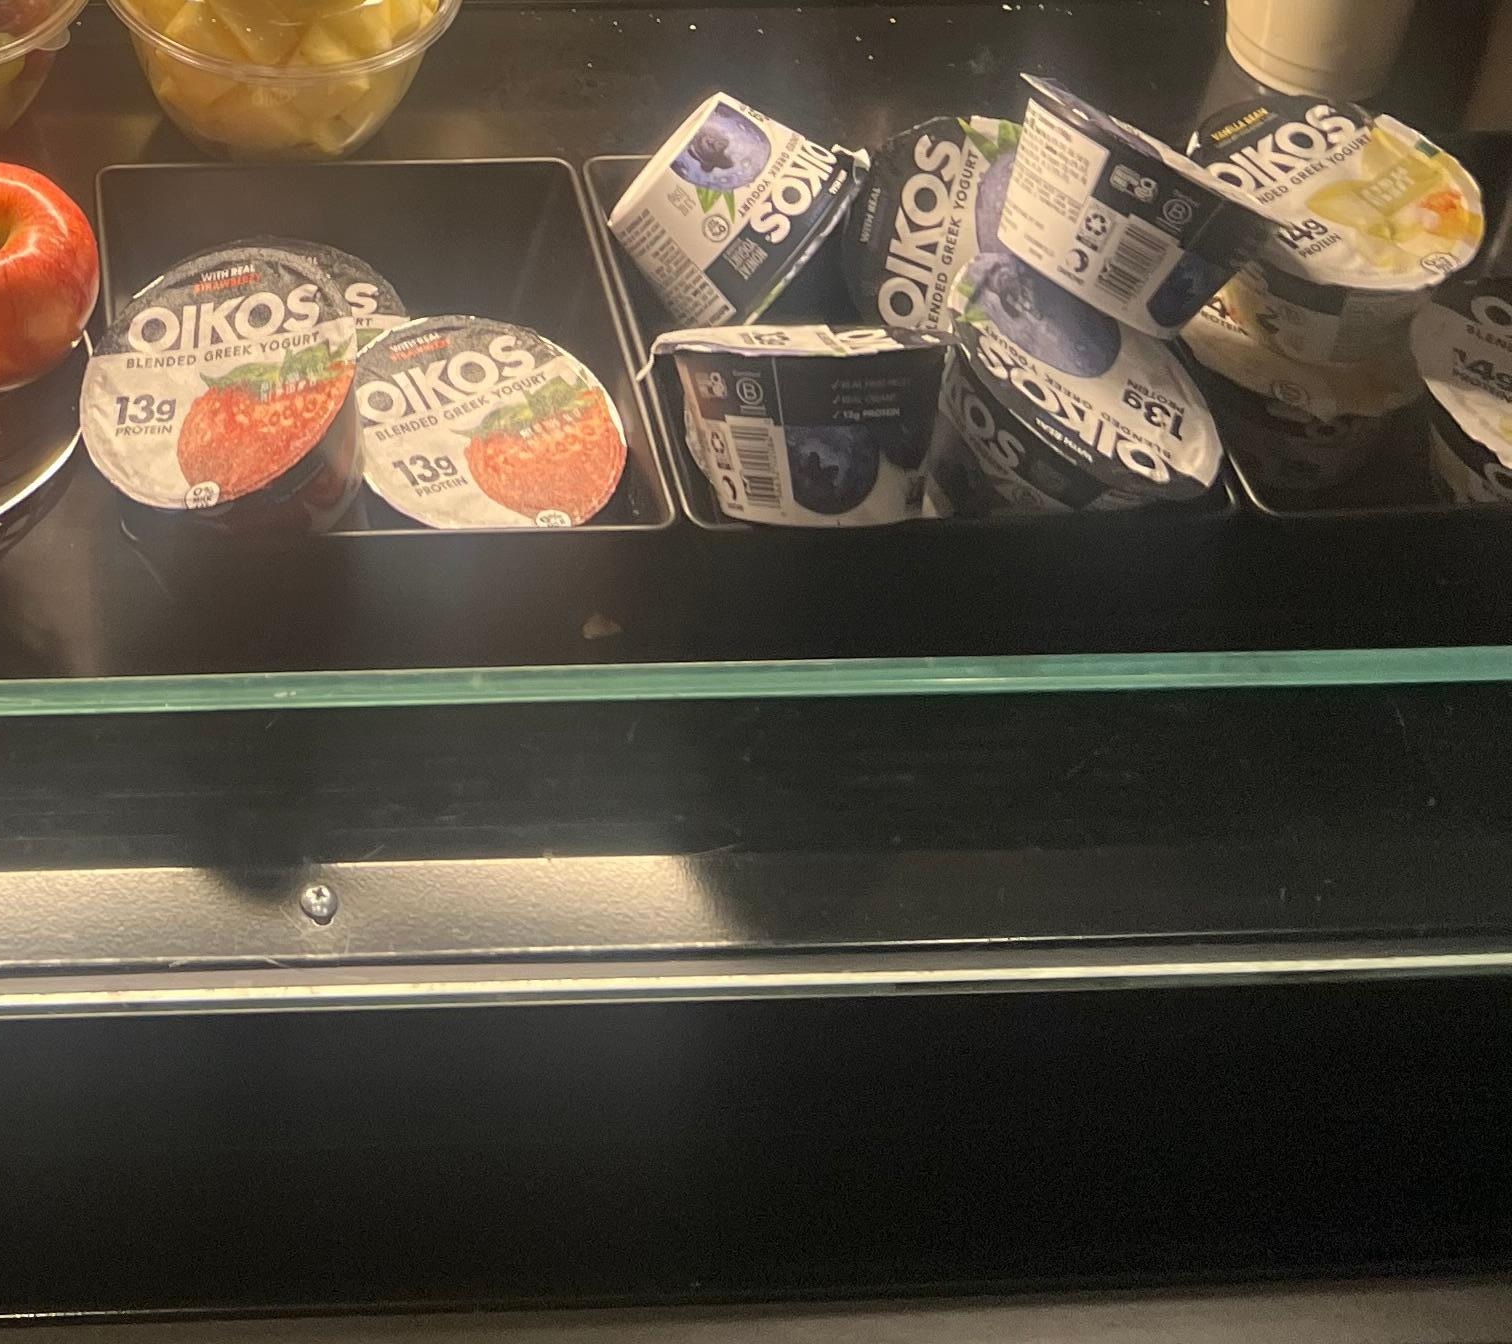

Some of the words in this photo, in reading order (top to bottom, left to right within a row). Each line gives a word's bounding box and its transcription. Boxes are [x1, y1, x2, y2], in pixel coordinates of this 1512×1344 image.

[1207, 104, 1357, 195] OIKOS
[1290, 163, 1325, 186] GREEK
[1328, 133, 1373, 166] YOGURT
[737, 178, 772, 217] YOGURT
[749, 139, 838, 245] OIKOS
[878, 134, 961, 330] OIKOS
[925, 272, 948, 330] LENDED
[941, 215, 963, 266] GREEK
[952, 149, 980, 213] YOGURT
[200, 269, 230, 283] WITH
[231, 263, 256, 278] REAL
[128, 284, 321, 354] OIKOS
[125, 354, 197, 370] BLENDED
[204, 344, 253, 363] GREEK
[259, 332, 320, 355] YOGURT
[355, 334, 536, 425] OIKOS
[375, 415, 439, 442] BLENDED
[443, 396, 491, 420] GREEK
[491, 371, 550, 400] YOGURT
[114, 424, 174, 438] PROTEIN
[115, 394, 177, 426] 13g
[978, 334, 1171, 484] OIKOS
[1121, 388, 1186, 442] 13g
[392, 454, 459, 488] 13g
[414, 476, 470, 499] PROTEIN
